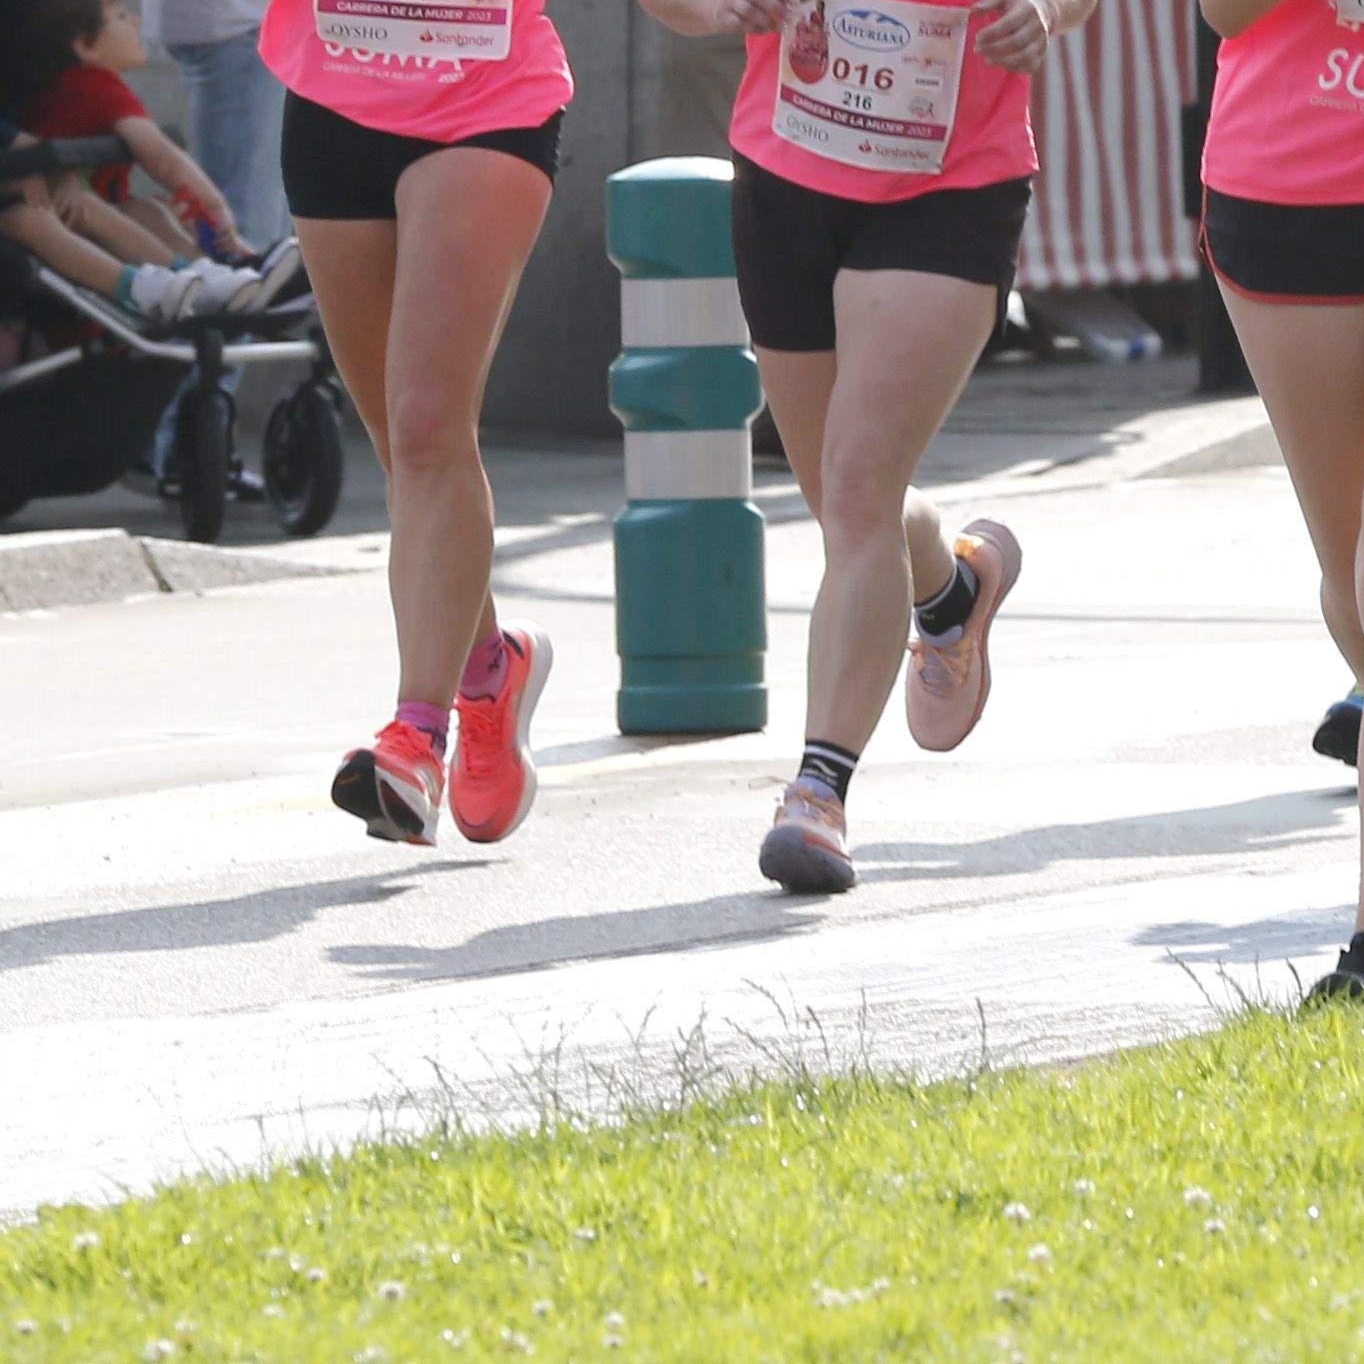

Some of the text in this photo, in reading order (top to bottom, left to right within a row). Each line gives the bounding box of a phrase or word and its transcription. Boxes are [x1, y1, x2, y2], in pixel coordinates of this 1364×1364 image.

[336, 1, 388, 15] CARRERA
[390, 6, 406, 16] DE
[408, 8, 425, 18] LA
[425, 9, 463, 20] MUJER
[331, 22, 388, 40] OYSHO
[436, 33, 494, 47] Santander
[839, 17, 904, 45] ASTURIANA
[832, 57, 895, 90] 016
[842, 90, 873, 111] 216
[850, 113, 864, 127] LA
